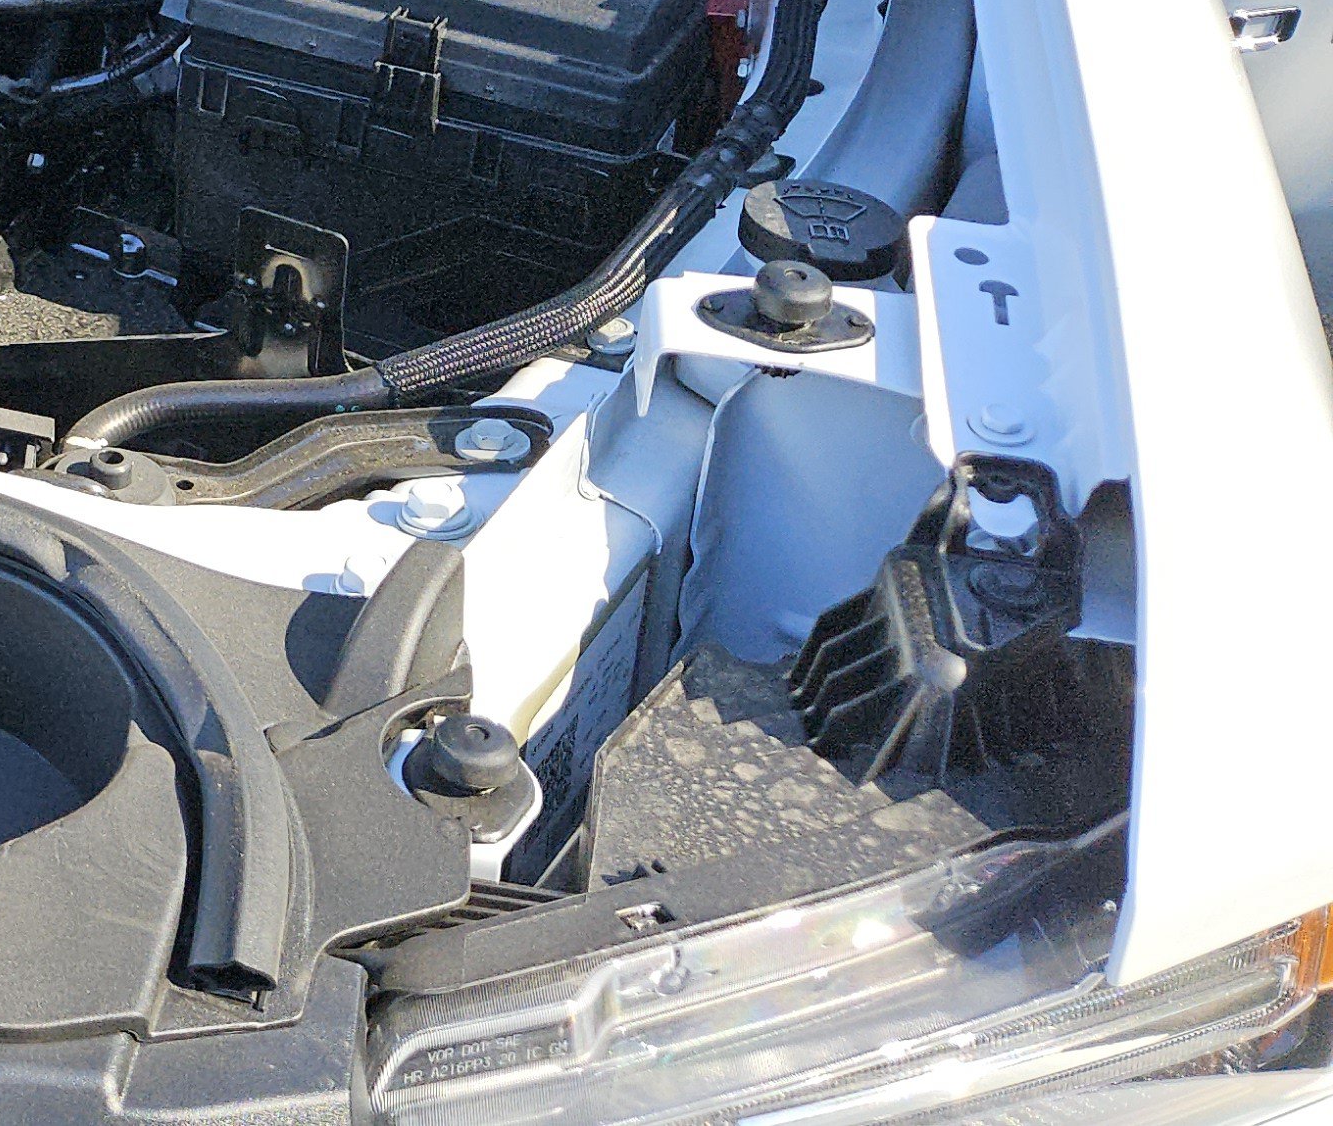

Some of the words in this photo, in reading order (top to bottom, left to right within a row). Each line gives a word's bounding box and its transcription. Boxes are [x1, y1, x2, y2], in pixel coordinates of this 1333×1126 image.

[427, 1047, 454, 1063] VOR
[462, 1042, 486, 1058] DOT
[495, 1034, 522, 1049] SAE
[403, 1070, 424, 1085] HR
